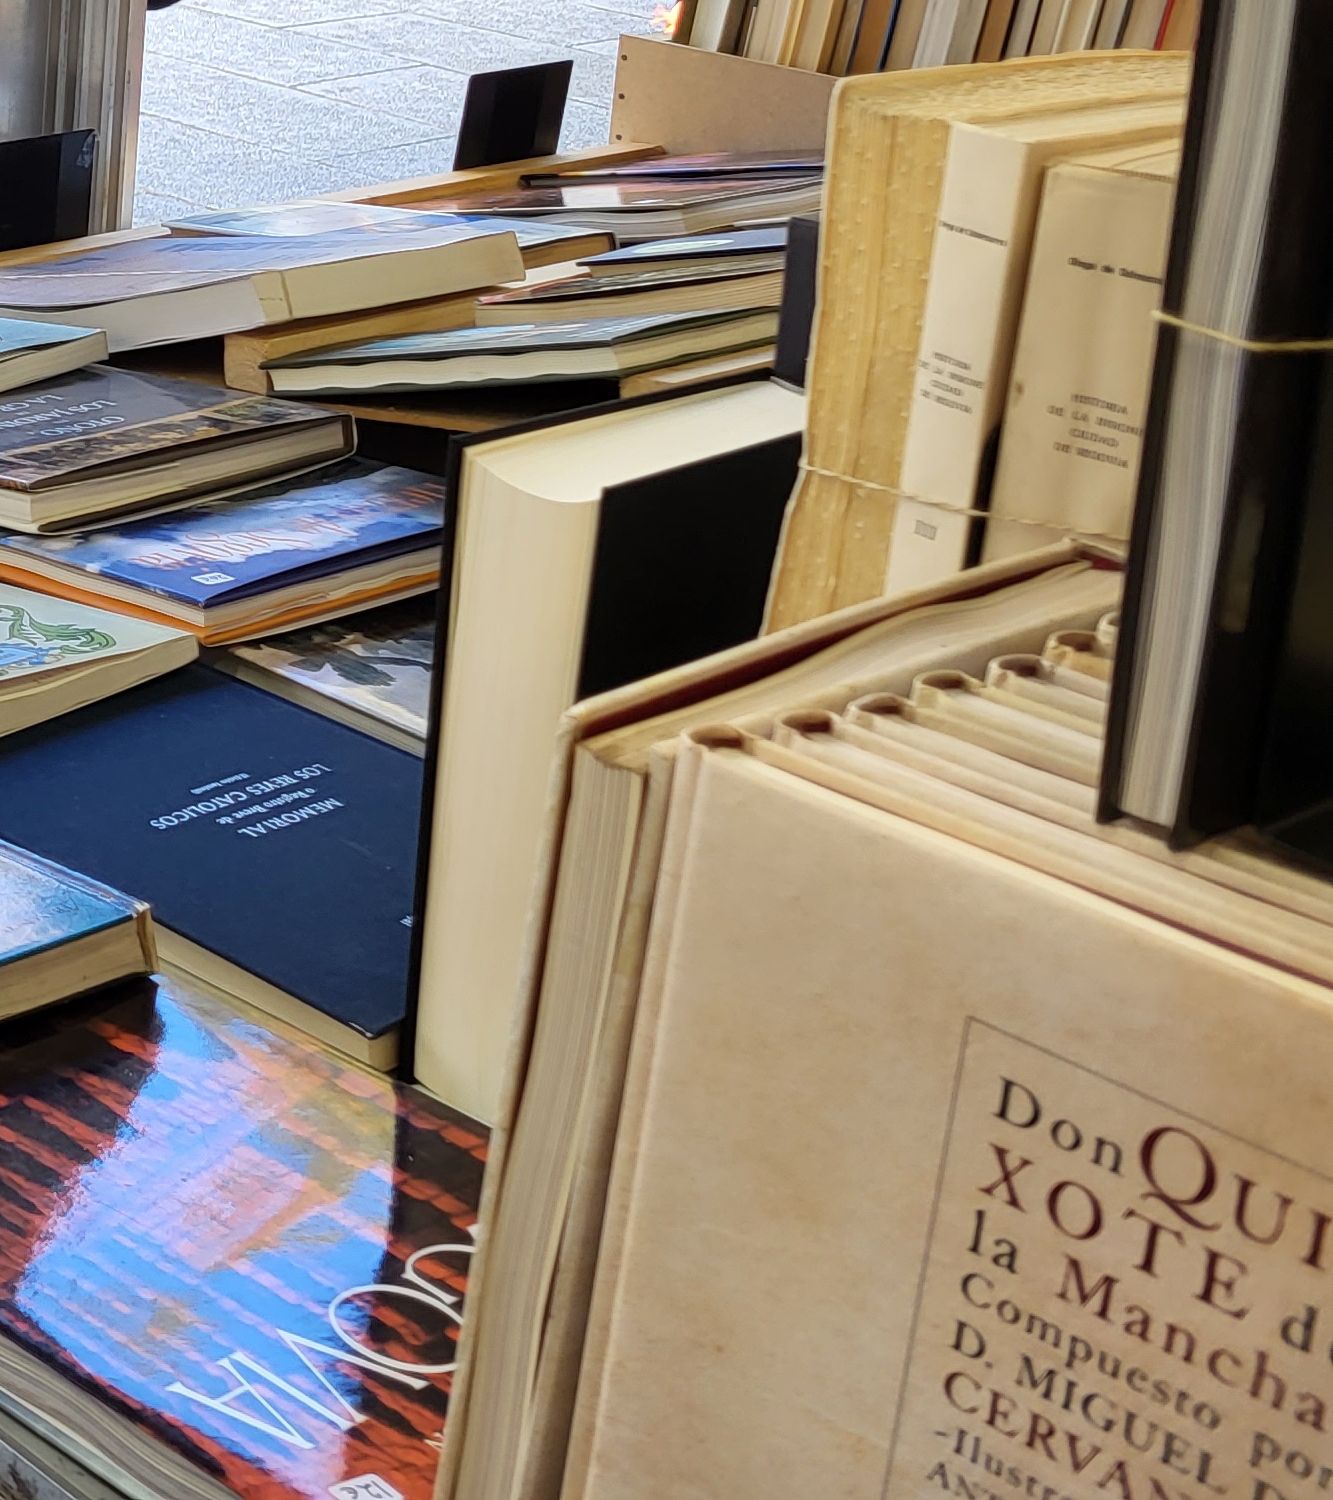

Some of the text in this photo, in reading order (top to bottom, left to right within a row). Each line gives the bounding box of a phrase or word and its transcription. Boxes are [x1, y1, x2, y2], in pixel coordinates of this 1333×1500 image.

[30, 394, 65, 404] LA
[67, 399, 117, 413] LOS
[245, 774, 300, 796] REYES
[293, 763, 334, 780] LOS
[149, 791, 249, 831] CATOLICOS
[232, 804, 270, 820] Breve
[263, 788, 311, 810] Registro
[214, 813, 234, 826] de
[236, 797, 345, 838] MEMORIAL
[992, 1075, 1125, 1179] Don
[977, 1142, 1333, 1365] XOTE d
[967, 1209, 1331, 1435] la Mancha
[960, 1272, 1223, 1432] Compuesto
[949, 1318, 994, 1370] D.
[1014, 1353, 1229, 1496] MIGUEL
